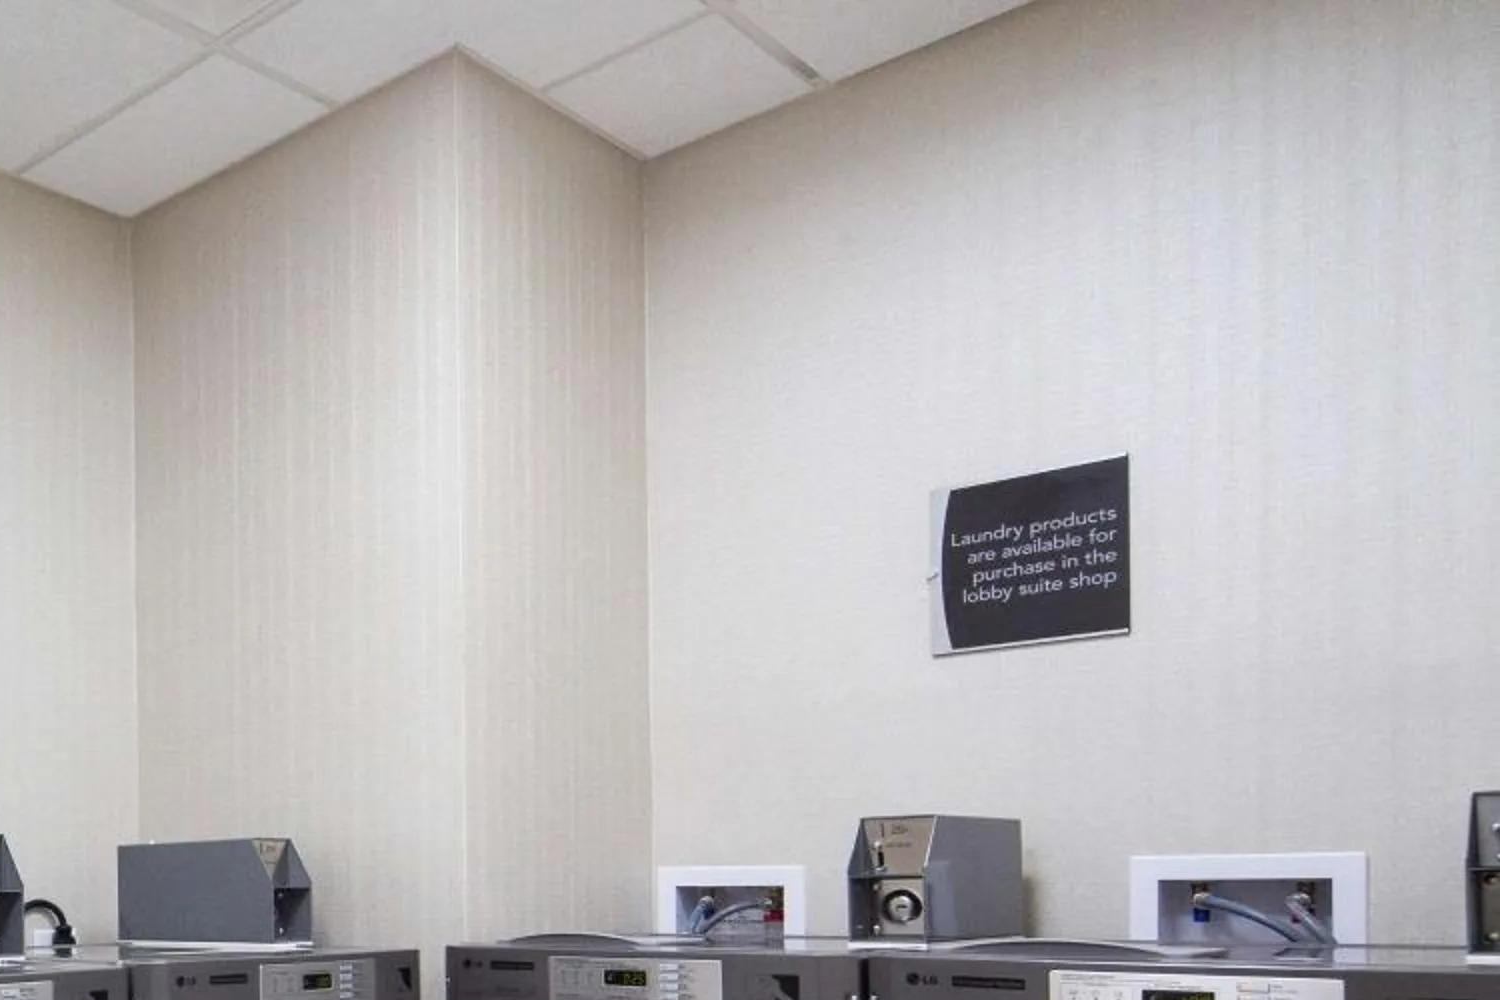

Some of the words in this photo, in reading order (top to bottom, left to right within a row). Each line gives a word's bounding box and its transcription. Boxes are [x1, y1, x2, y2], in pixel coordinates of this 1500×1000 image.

[951, 524, 1024, 547] Laundry
[1029, 509, 1117, 538] products
[967, 550, 996, 564] are
[1001, 533, 1083, 559] available
[1088, 527, 1117, 543] for
[972, 561, 1056, 587] purchase
[1062, 557, 1079, 569] in
[1084, 548, 1118, 565] the
[963, 585, 1013, 603] lobby
[1019, 579, 1063, 595] suite
[1069, 571, 1117, 589] shop
